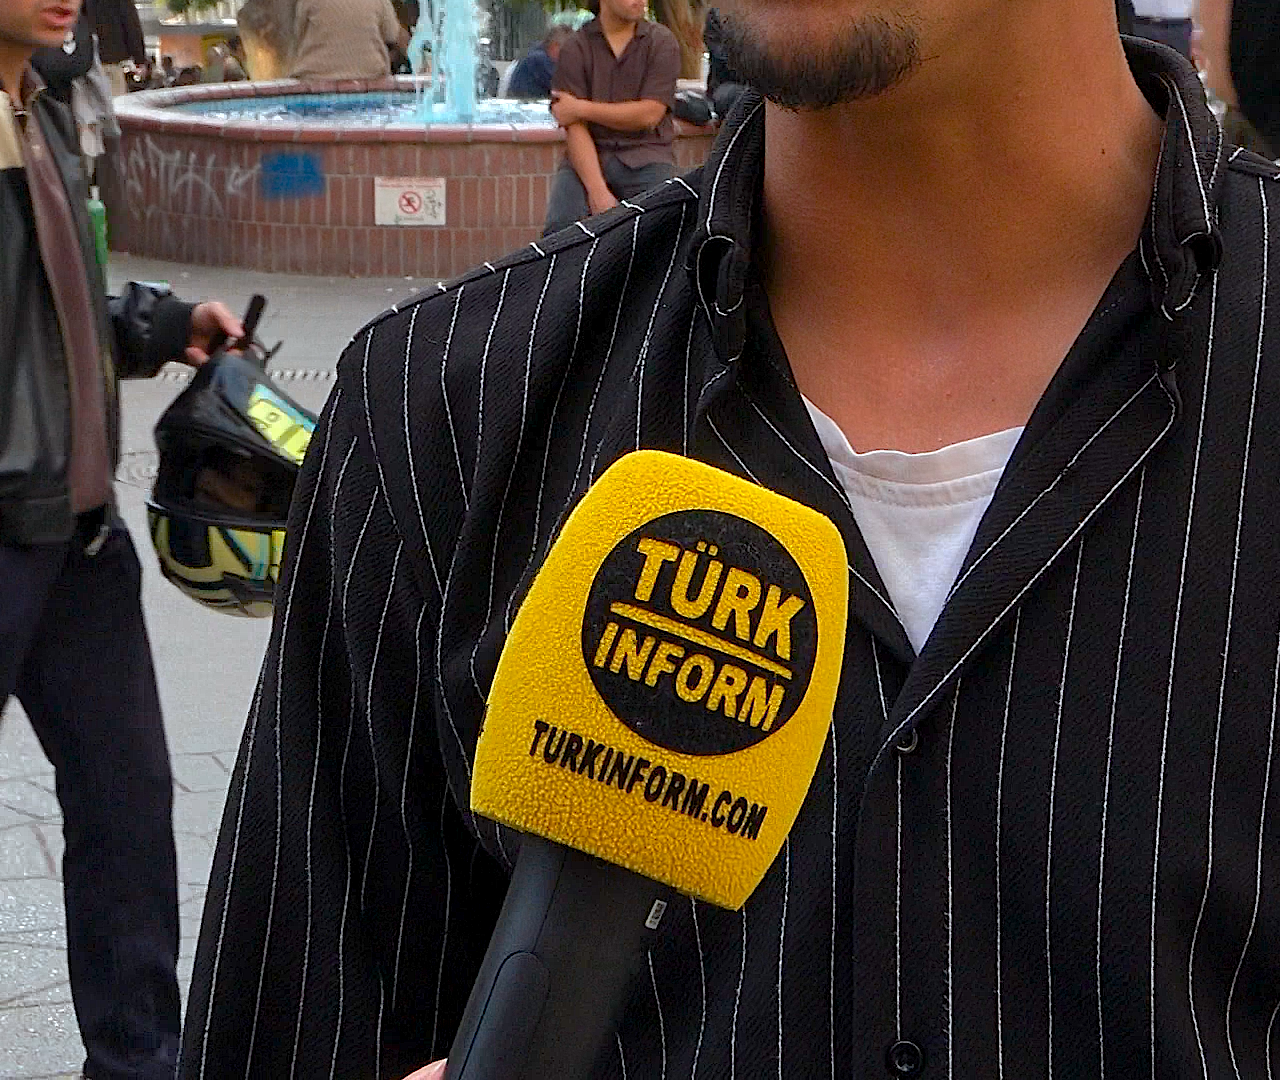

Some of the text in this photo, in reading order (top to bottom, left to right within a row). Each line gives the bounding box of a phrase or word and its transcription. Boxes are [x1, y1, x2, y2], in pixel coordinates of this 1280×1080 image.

[635, 536, 806, 661] TÜRK
[593, 621, 787, 732] INFORM
[528, 719, 769, 841] TURKINFORM.COM
